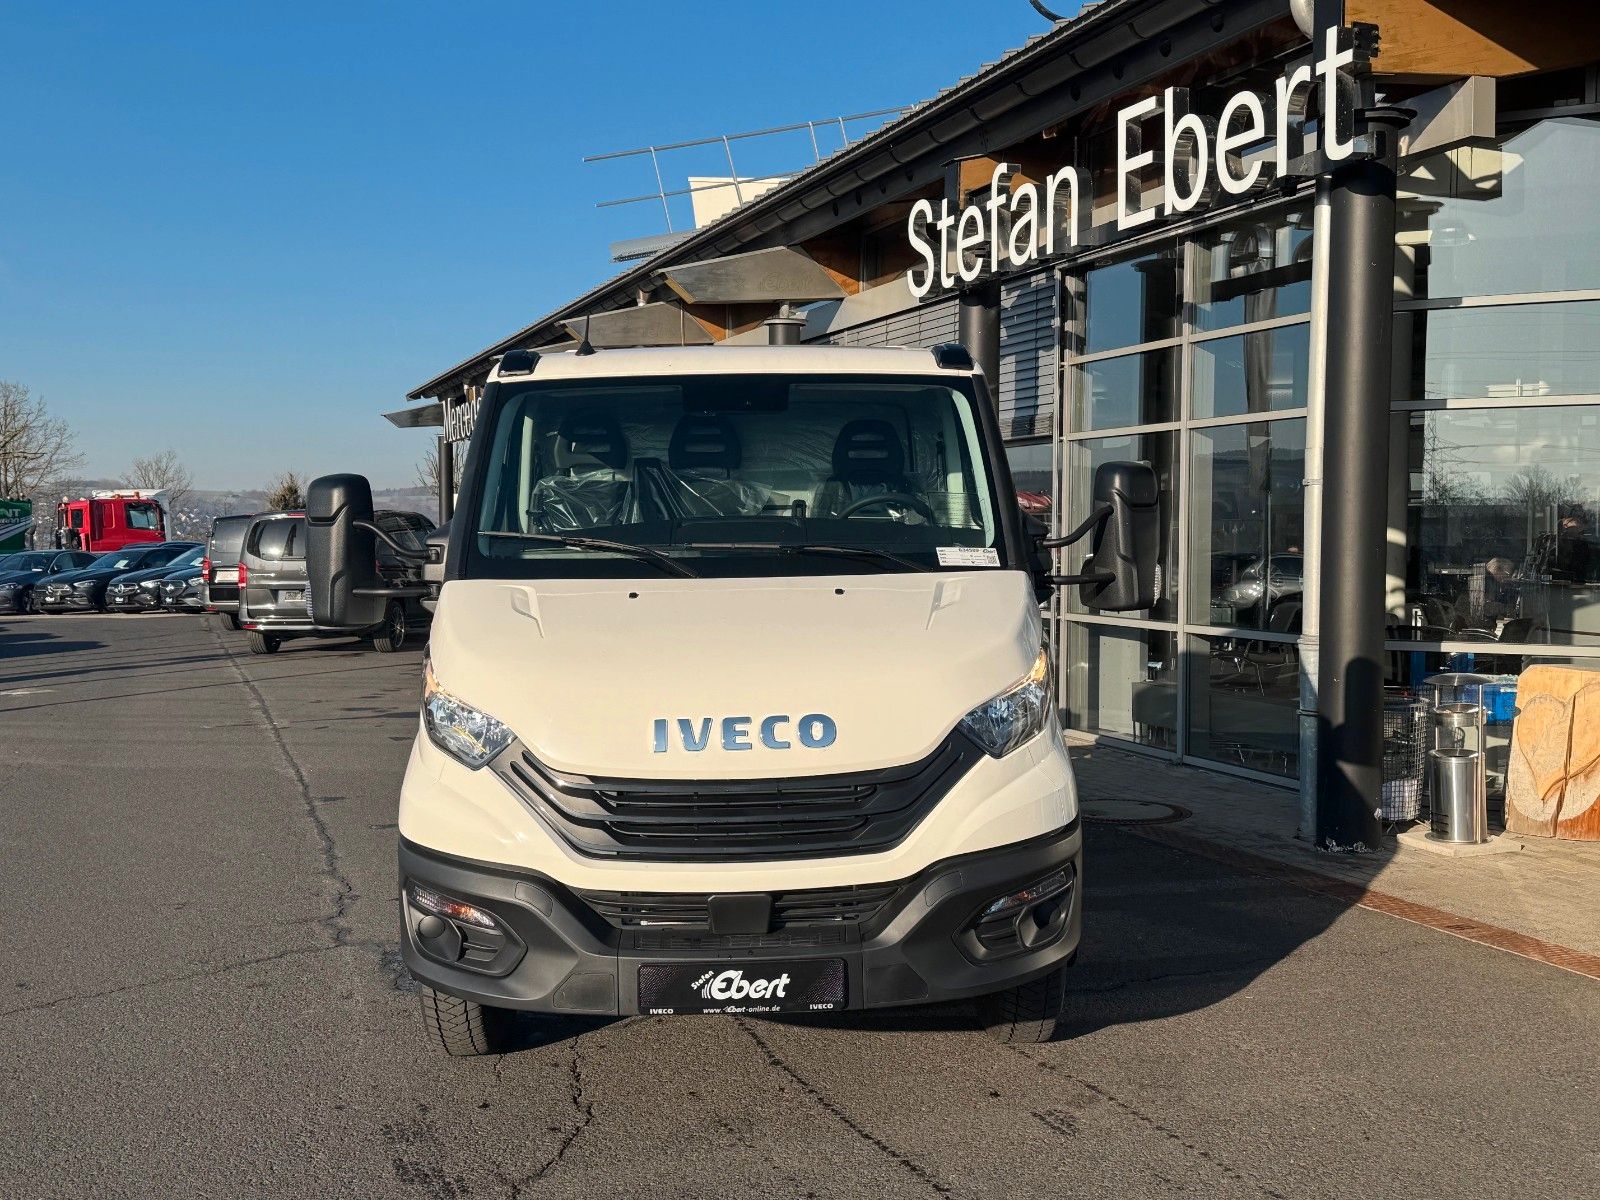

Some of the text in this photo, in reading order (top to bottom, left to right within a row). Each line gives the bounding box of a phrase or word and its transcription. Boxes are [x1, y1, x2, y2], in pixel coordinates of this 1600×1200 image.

[907, 25, 1355, 299] Stefan Ebert
[653, 713, 838, 753] IVECO
[690, 970, 715, 990] Stefan
[710, 969, 791, 1001] Ebert
